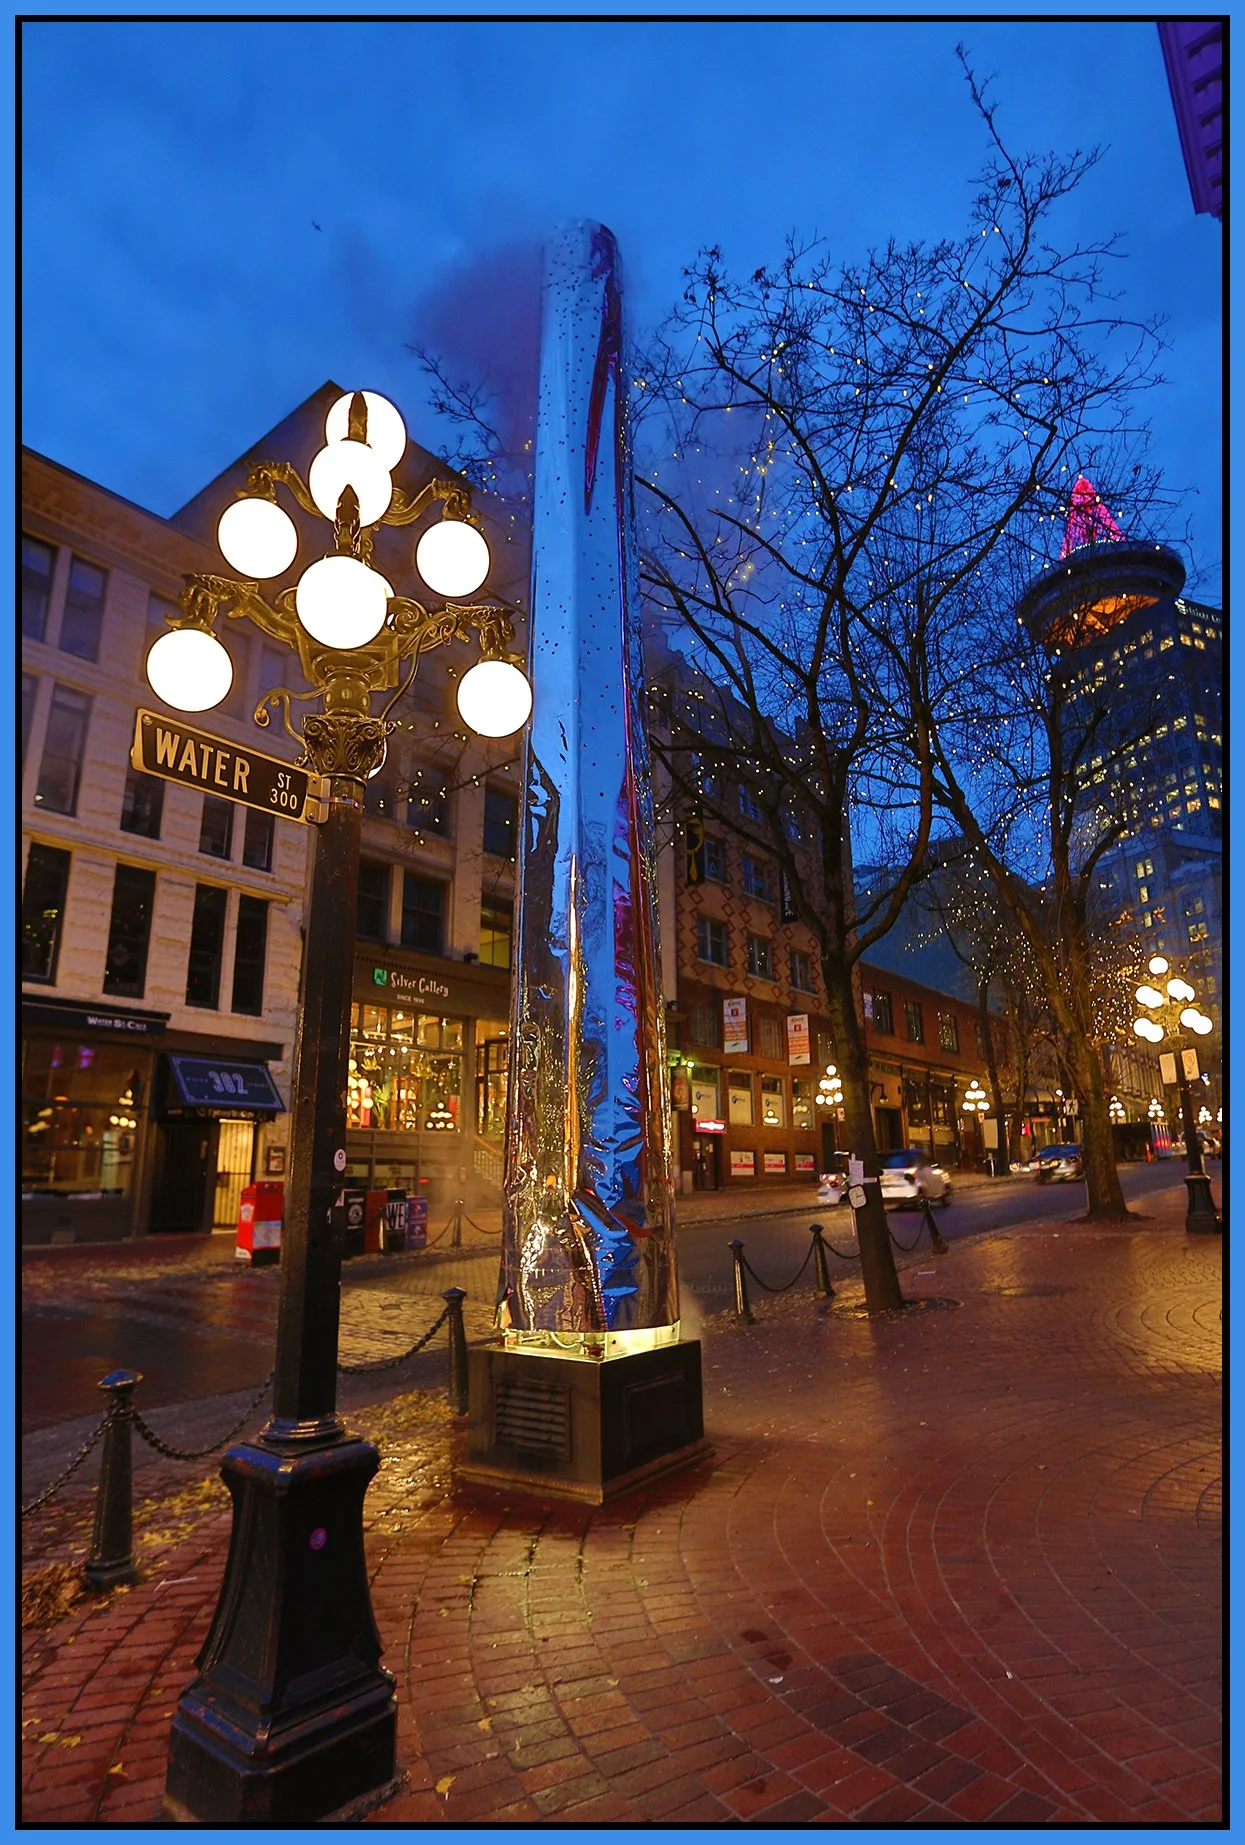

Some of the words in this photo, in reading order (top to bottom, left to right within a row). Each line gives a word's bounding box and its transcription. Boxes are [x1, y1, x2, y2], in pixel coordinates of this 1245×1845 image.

[156, 727, 250, 794] WATER
[277, 772, 292, 790] ST
[270, 788, 298, 810] 300
[390, 972, 417, 989] Silver
[418, 977, 449, 997] Gallery
[208, 1070, 249, 1095] 302
